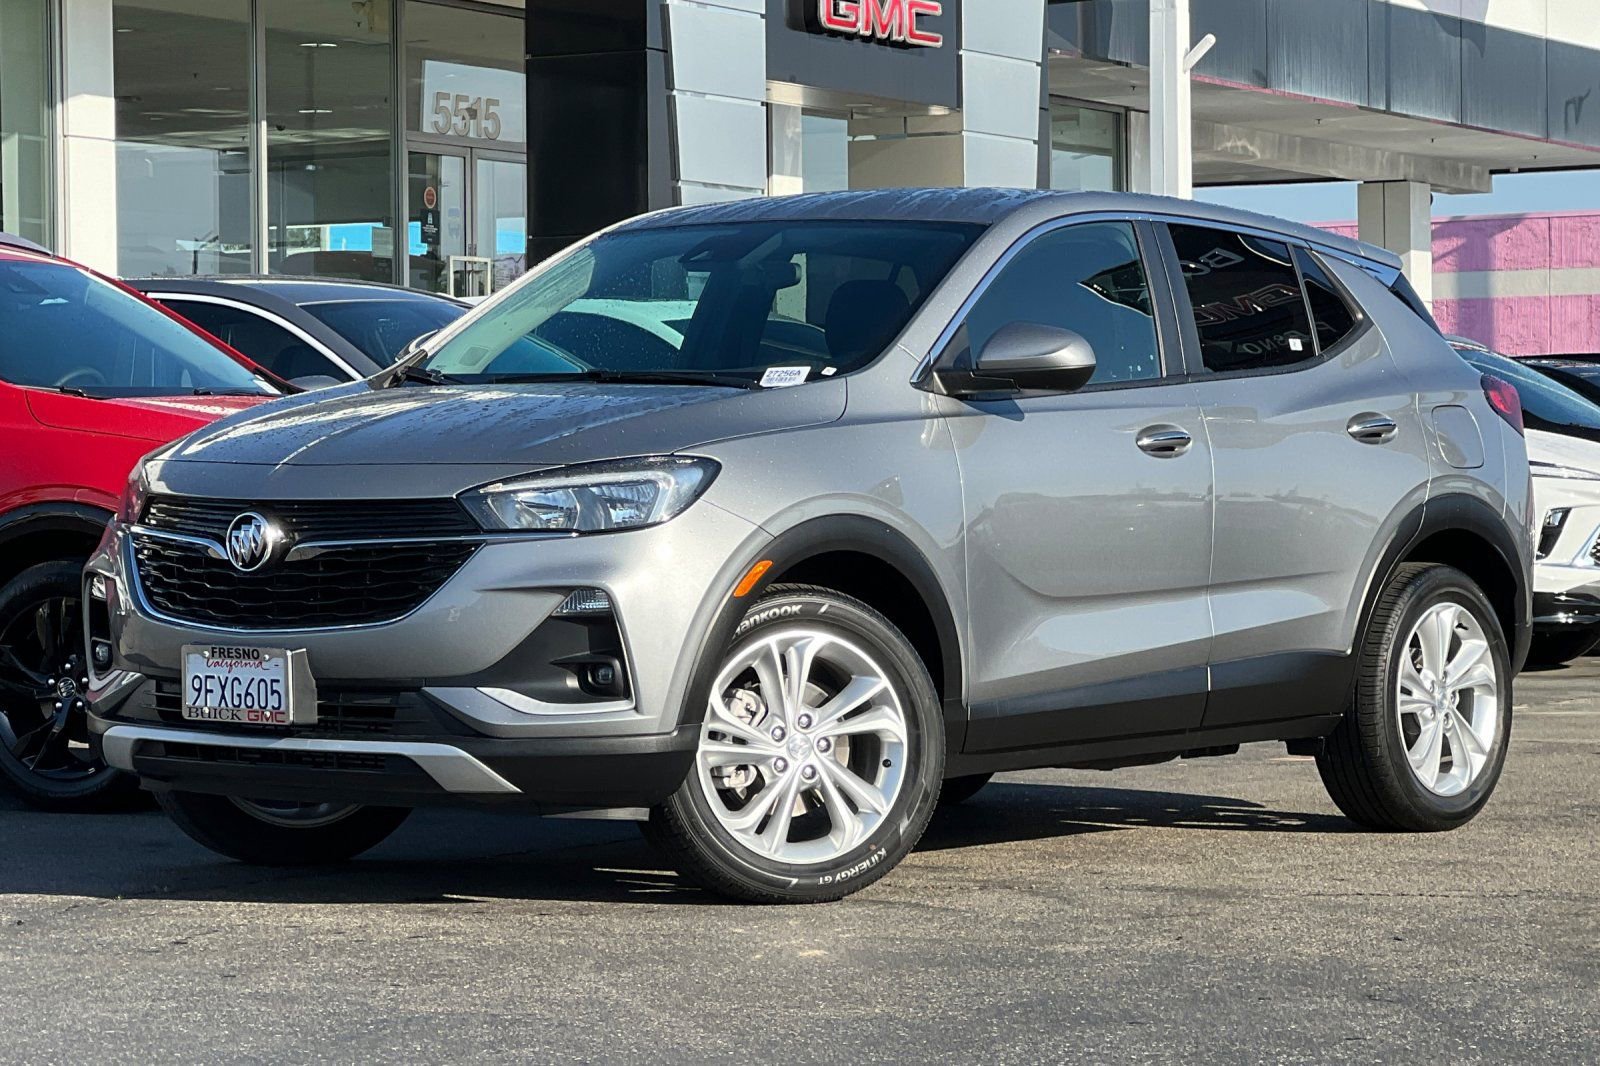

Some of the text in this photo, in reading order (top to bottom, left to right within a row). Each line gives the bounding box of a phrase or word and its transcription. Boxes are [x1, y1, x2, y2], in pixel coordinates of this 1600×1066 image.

[818, 0, 942, 48] GMC
[433, 91, 501, 140] 5515
[206, 659, 270, 674] California
[211, 647, 260, 660] FRESNO
[191, 674, 282, 710] 9FXG605
[187, 706, 286, 723] BUICK GMC
